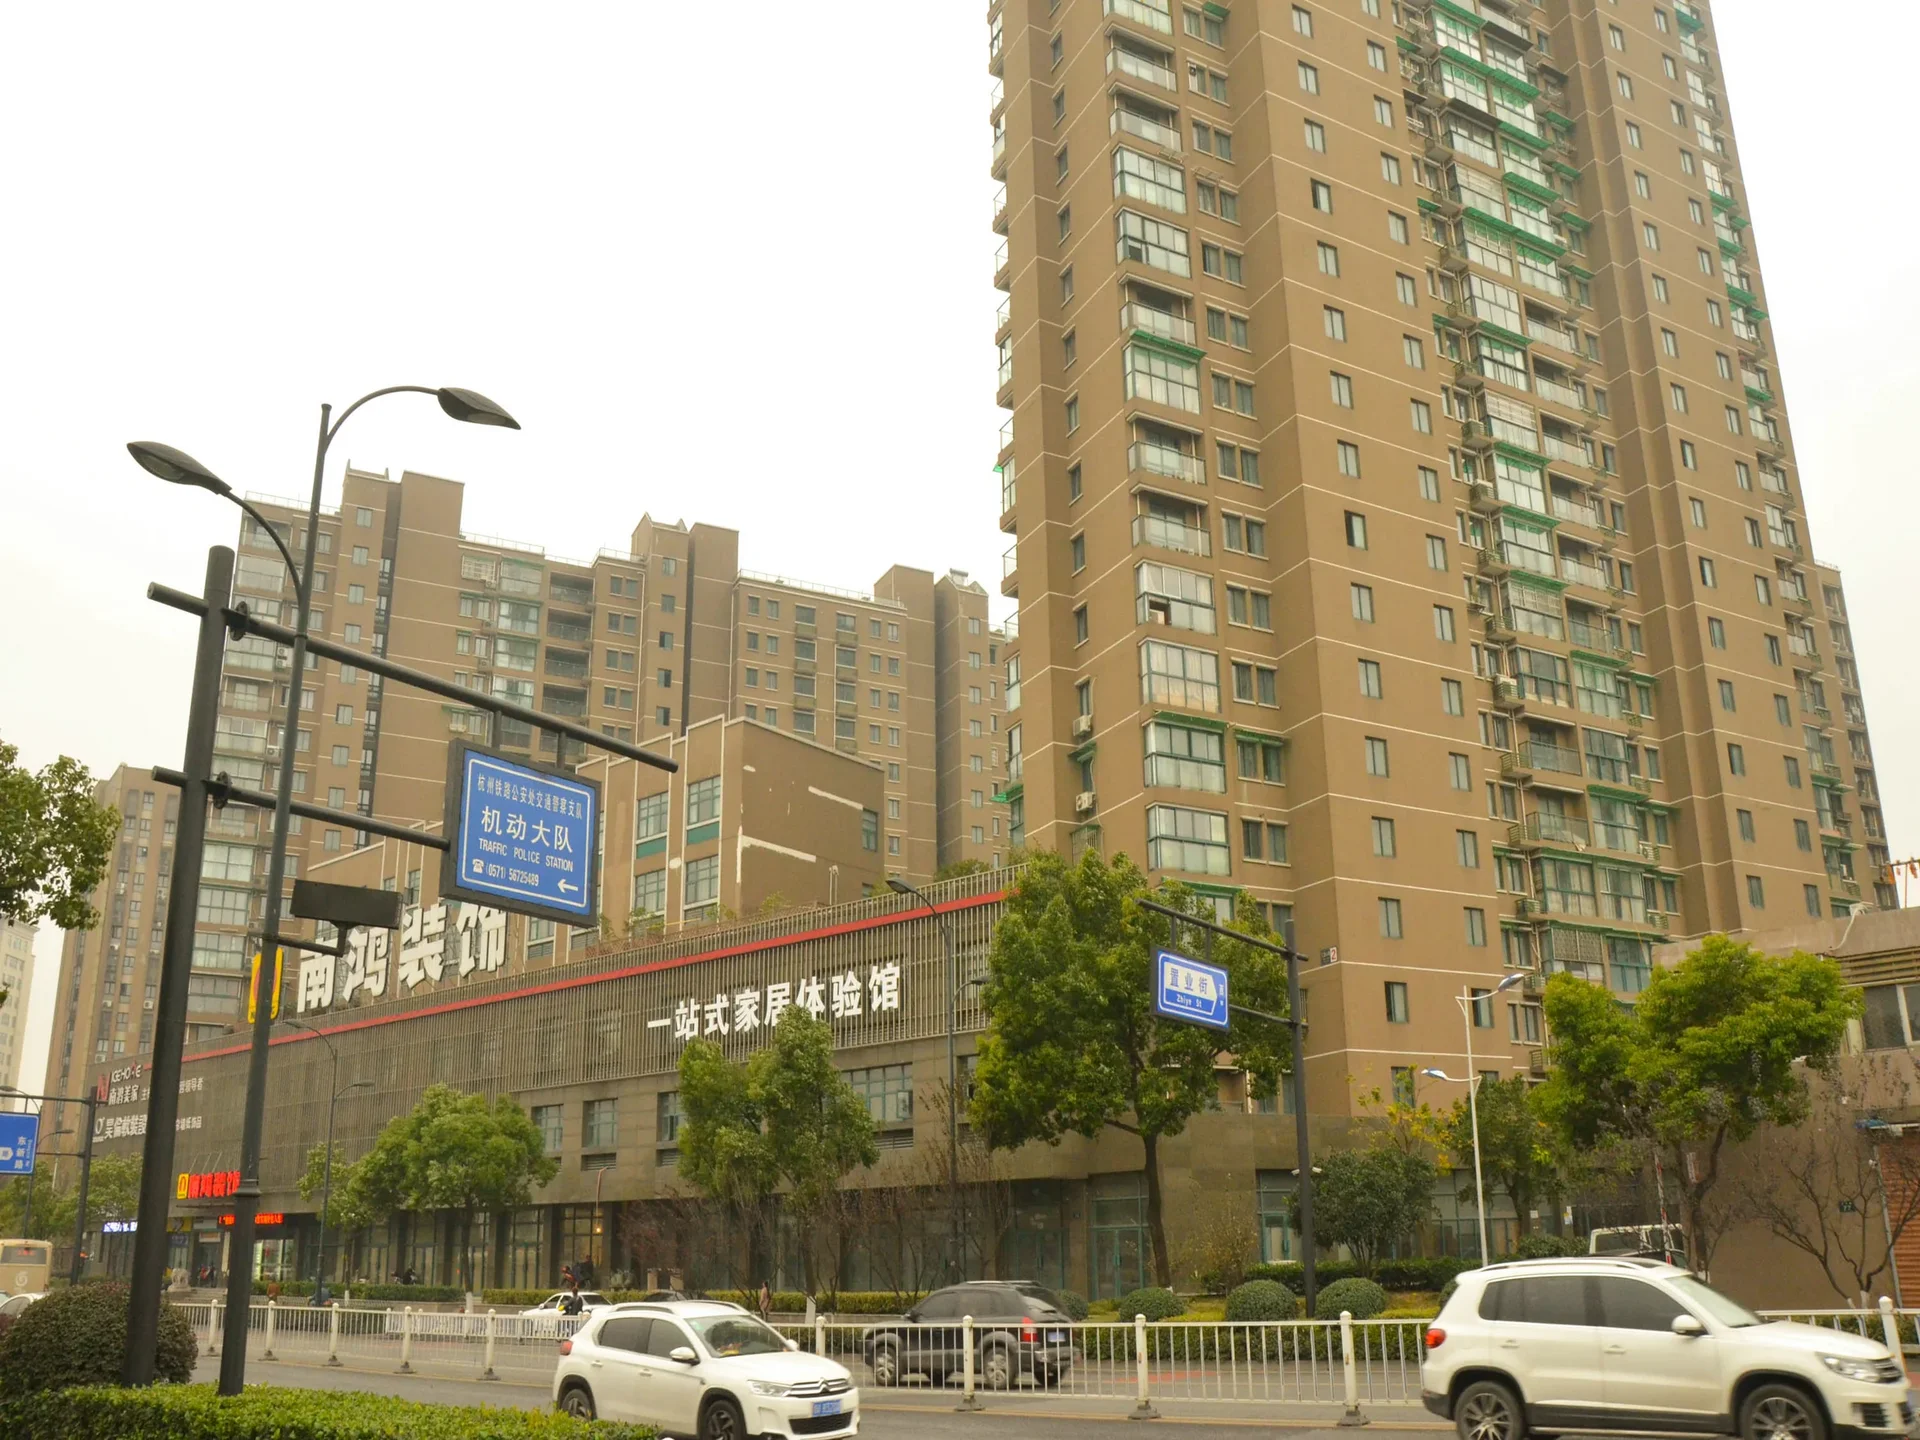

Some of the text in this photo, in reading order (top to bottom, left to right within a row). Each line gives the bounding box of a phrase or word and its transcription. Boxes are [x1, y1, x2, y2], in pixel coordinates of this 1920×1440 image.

[477, 774, 583, 820] 杭州铁路公安处交通警察支队
[481, 805, 574, 853] 机动大队
[478, 838, 574, 872] TRAFFIC POLICE STATION
[485, 863, 507, 879] (0571)
[297, 901, 508, 1013] 南鸿装饰
[647, 962, 901, 1041] 一站式家居体验馆
